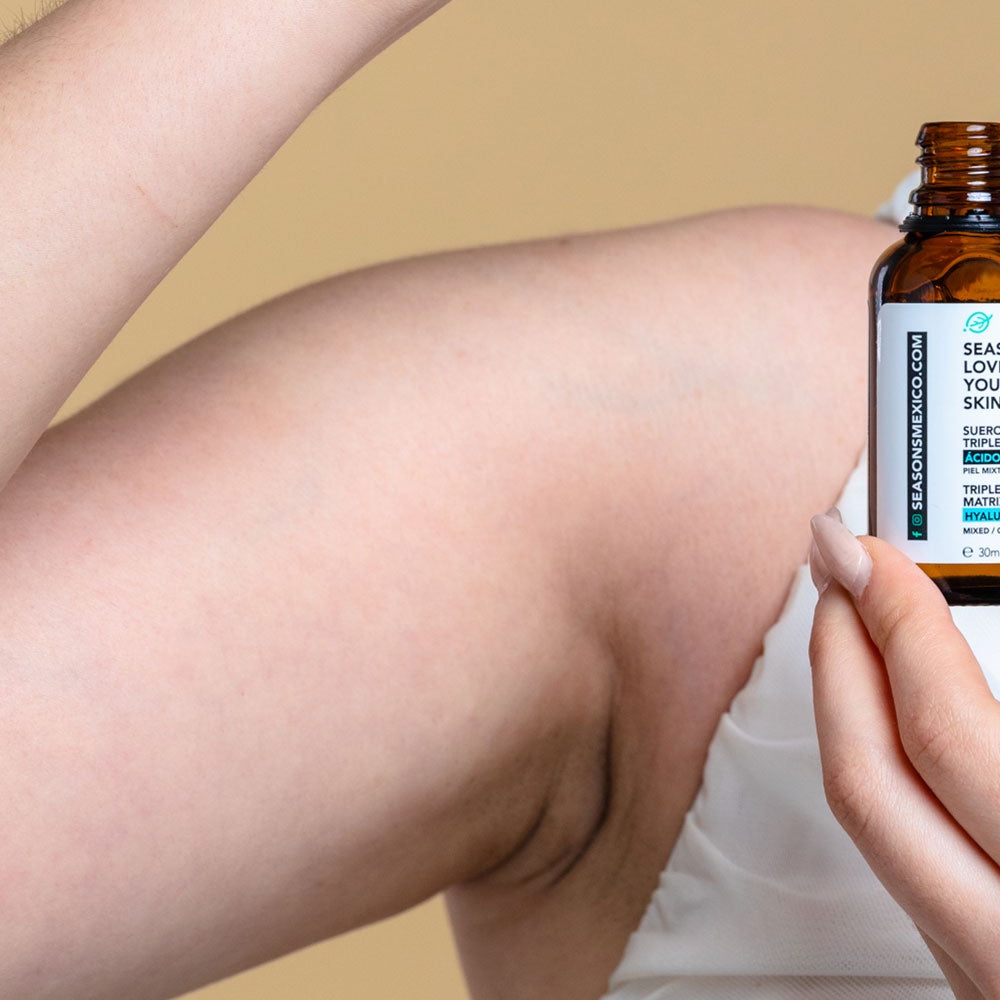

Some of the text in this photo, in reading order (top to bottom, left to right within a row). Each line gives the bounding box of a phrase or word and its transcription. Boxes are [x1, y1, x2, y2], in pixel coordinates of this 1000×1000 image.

[911, 334, 923, 510] SEASONSMEXICO.COM
[963, 438, 1000, 447] TRIPLE
[965, 451, 1000, 462] ÁCIDO
[963, 485, 1000, 494] TRIPLE
